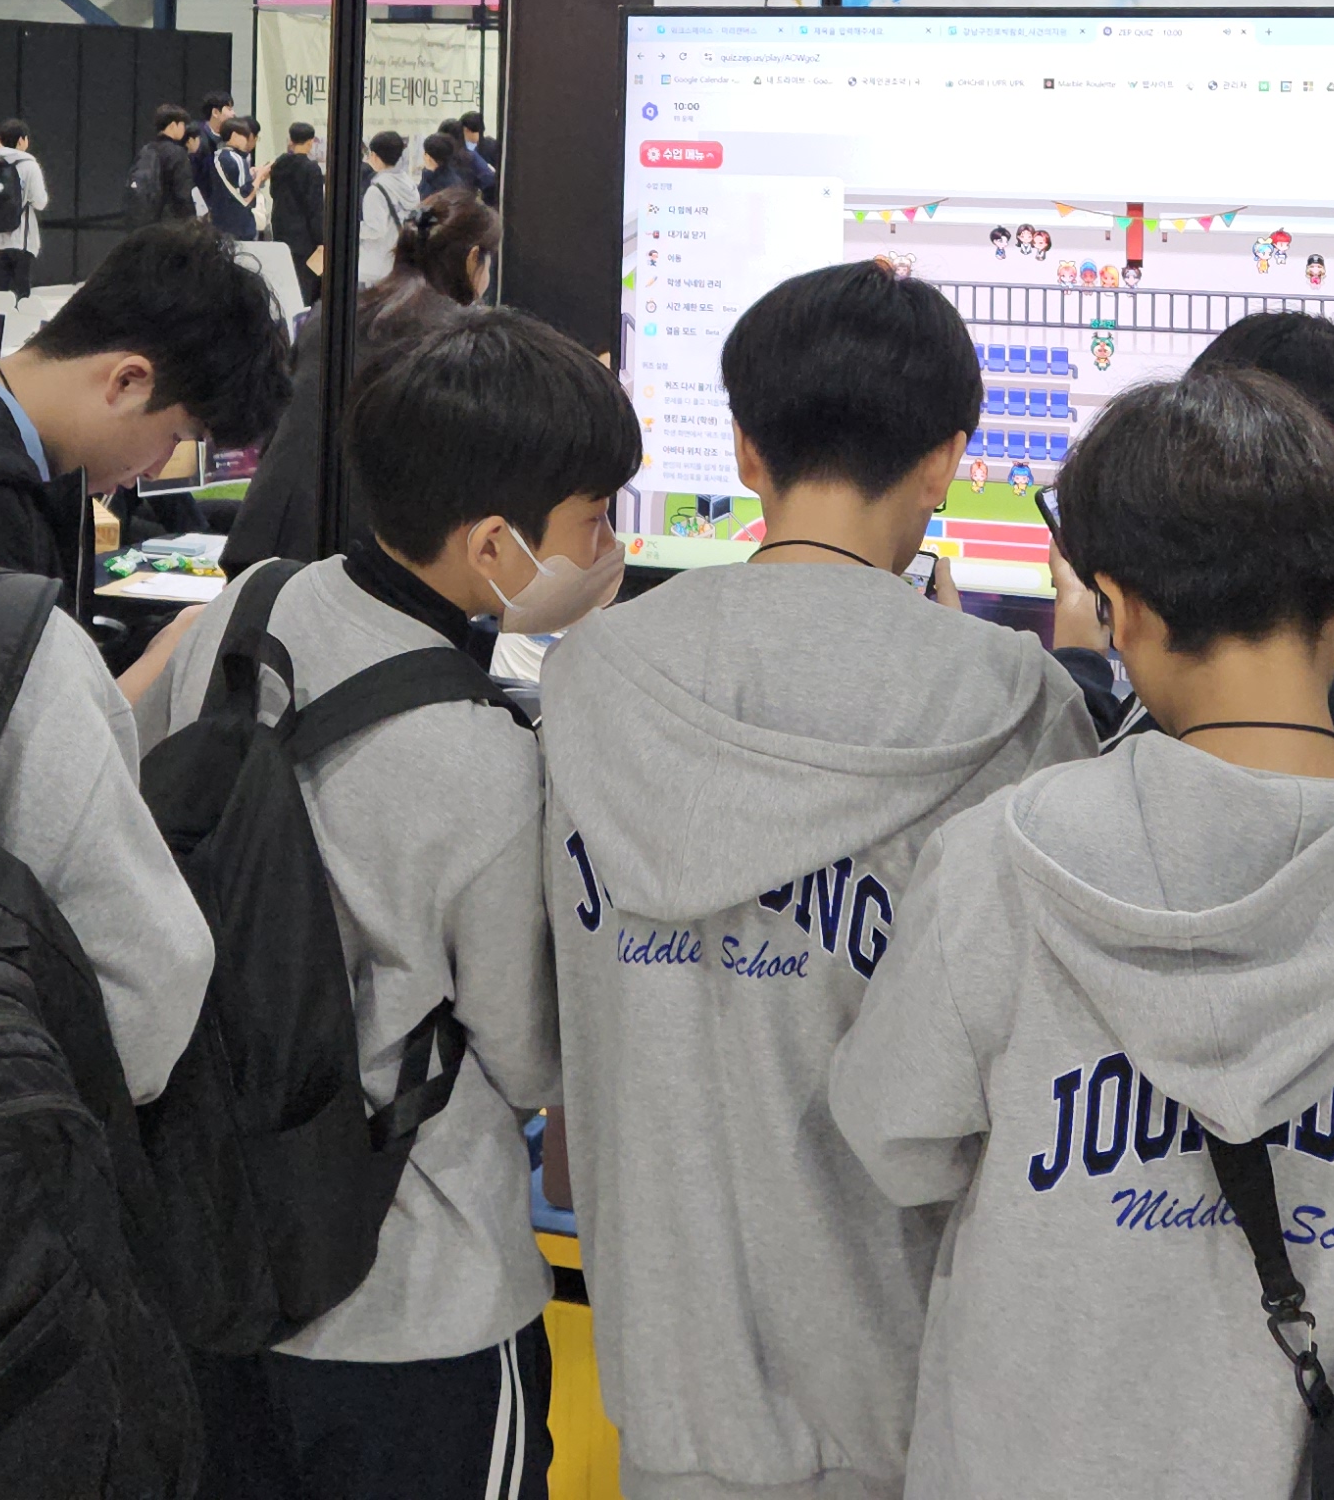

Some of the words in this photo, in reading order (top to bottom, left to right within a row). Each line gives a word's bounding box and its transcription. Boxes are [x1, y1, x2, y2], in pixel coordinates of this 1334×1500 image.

[389, 76, 438, 107] 트레이닝
[663, 149, 682, 161] 수업
[685, 149, 704, 161] 메뉴
[694, 207, 709, 215] 시작
[668, 231, 690, 239] 대기실
[667, 254, 681, 262] 이동
[667, 278, 681, 287] 학생
[707, 280, 721, 288] 관리
[667, 303, 681, 311] 시간
[699, 303, 714, 312] 모드
[683, 328, 697, 336] 모드
[665, 381, 679, 389] 퀴즈
[681, 382, 696, 391] 다시
[681, 415, 695, 424] 표시
[704, 448, 718, 456] 강조
[617, 928, 703, 966] iddle
[721, 935, 809, 979] School
